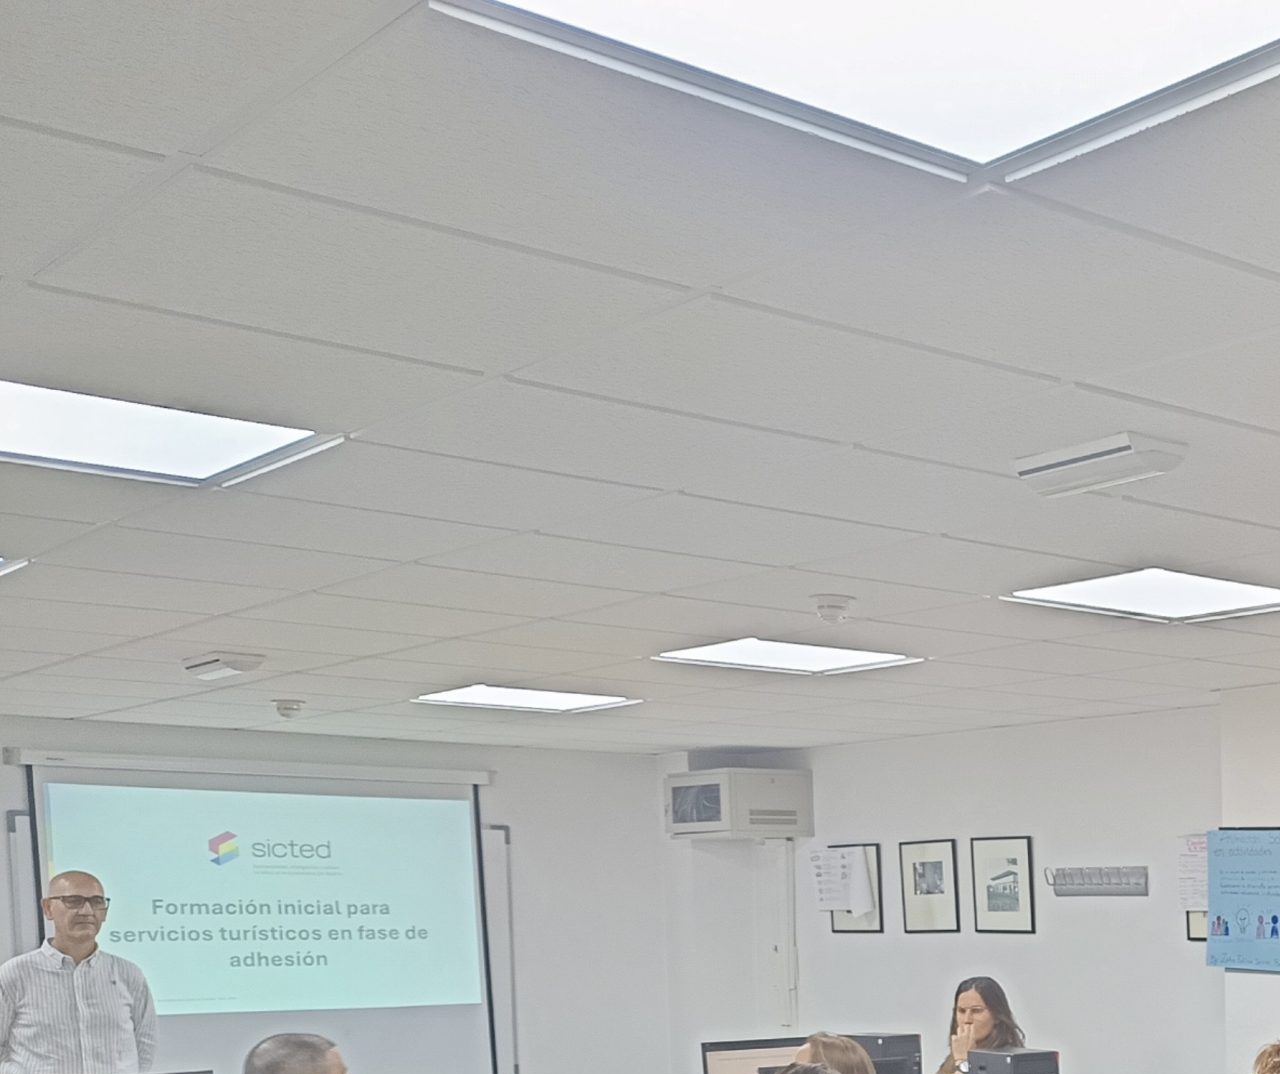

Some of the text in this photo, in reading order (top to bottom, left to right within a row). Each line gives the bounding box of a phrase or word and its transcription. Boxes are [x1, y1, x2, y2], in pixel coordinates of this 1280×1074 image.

[251, 838, 331, 859] sicted
[151, 898, 391, 918] Formación inicial para
[109, 924, 429, 943] servicios turísticos en fase de
[229, 950, 329, 968] adhesión
